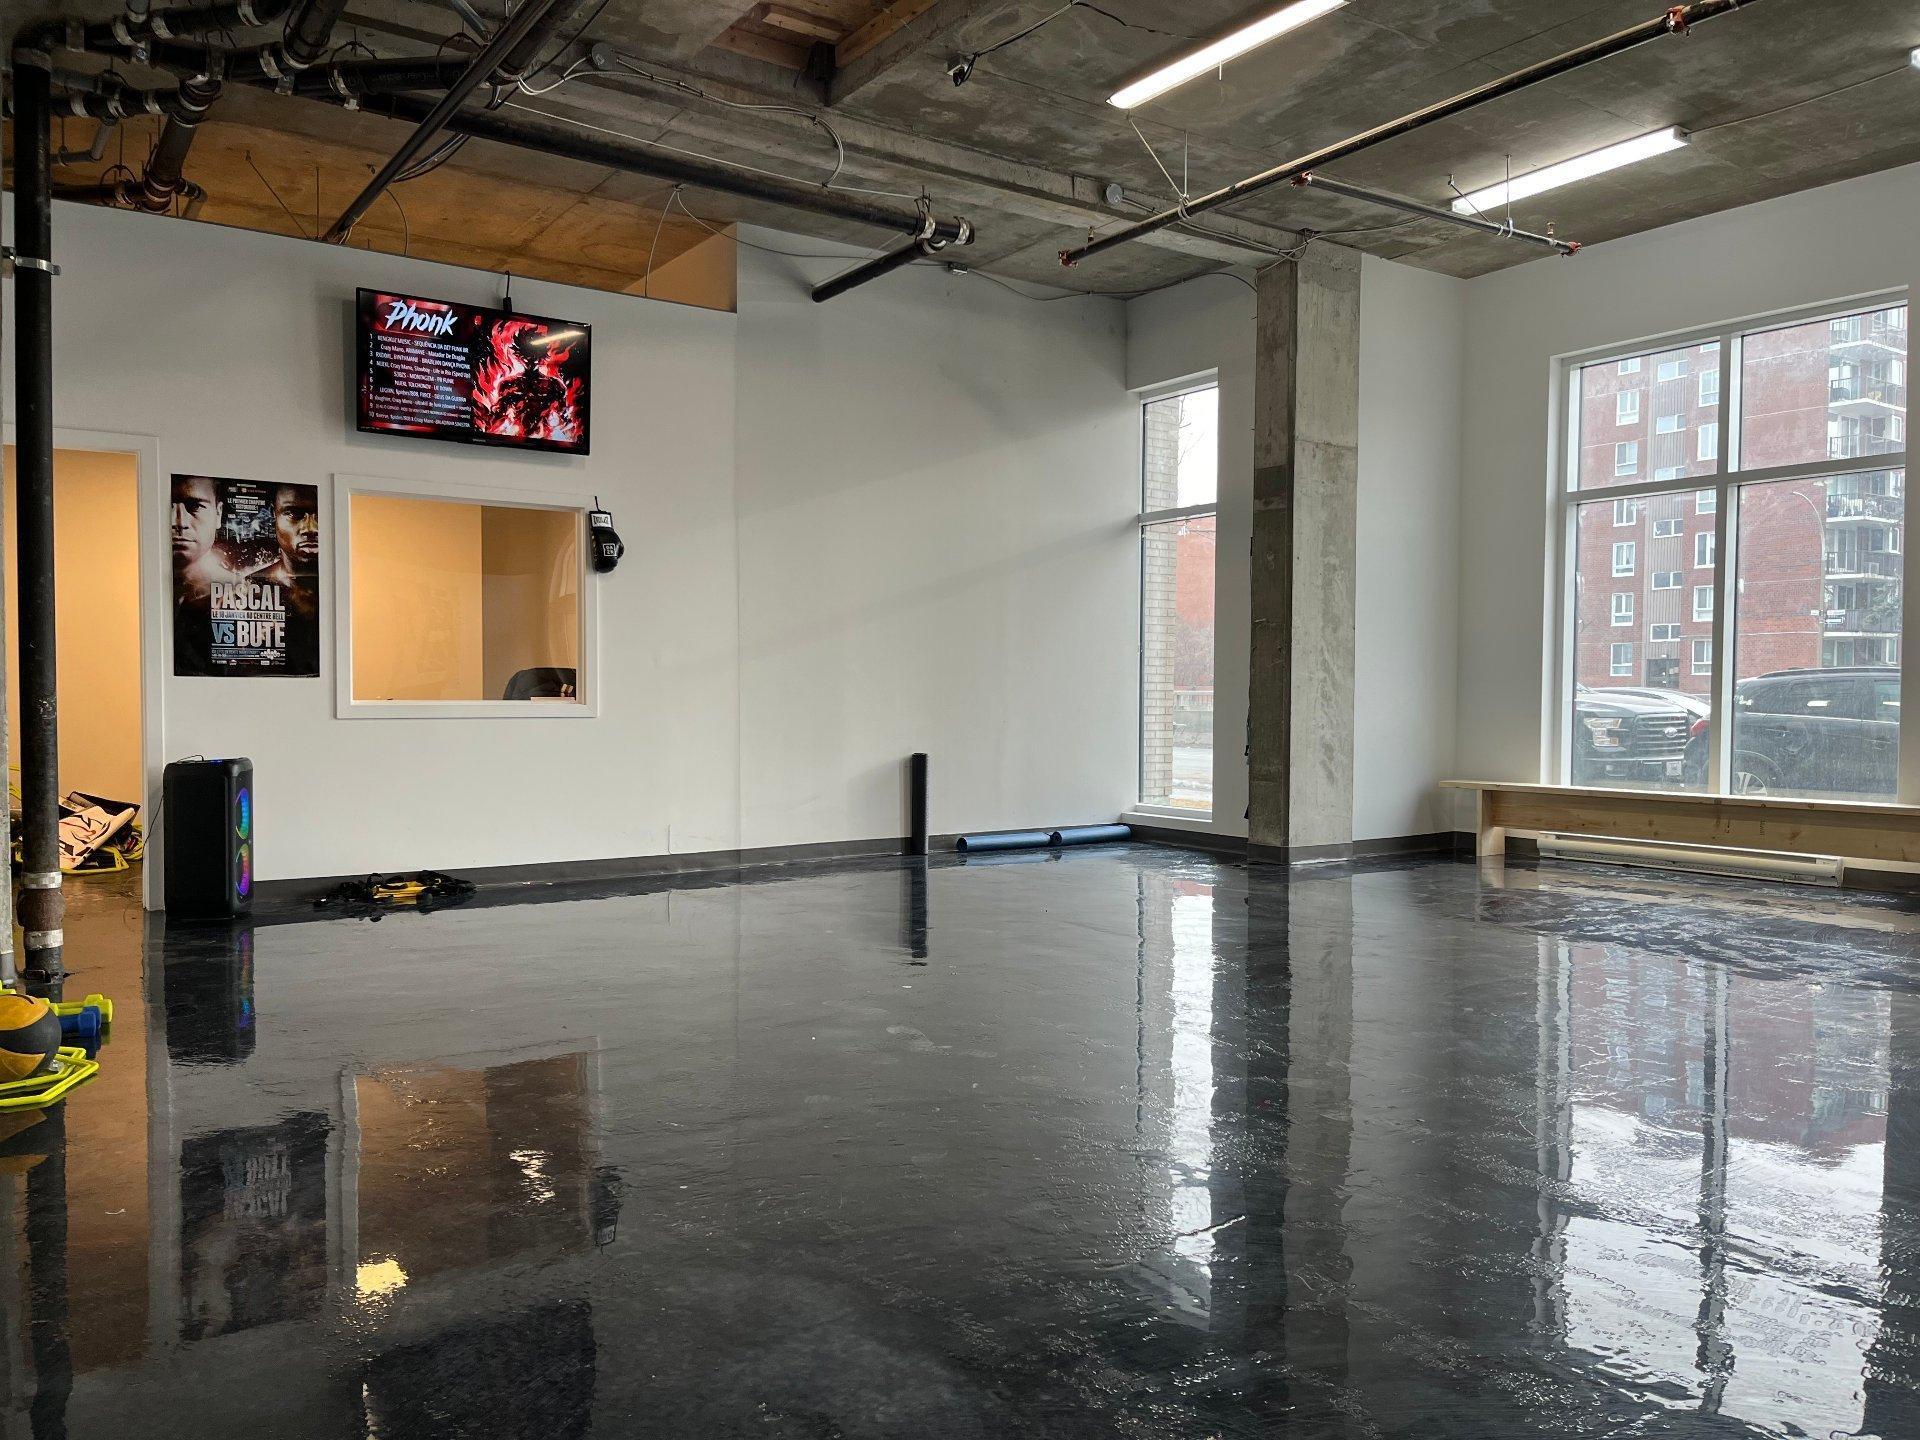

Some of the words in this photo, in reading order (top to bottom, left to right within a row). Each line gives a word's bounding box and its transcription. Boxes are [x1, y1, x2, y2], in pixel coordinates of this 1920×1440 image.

[385, 300, 458, 336] Phonk
[211, 582, 285, 611] PASCAL
[253, 612, 272, 620] CENTRE
[211, 623, 235, 643] VS
[237, 621, 285, 647] BUTE
